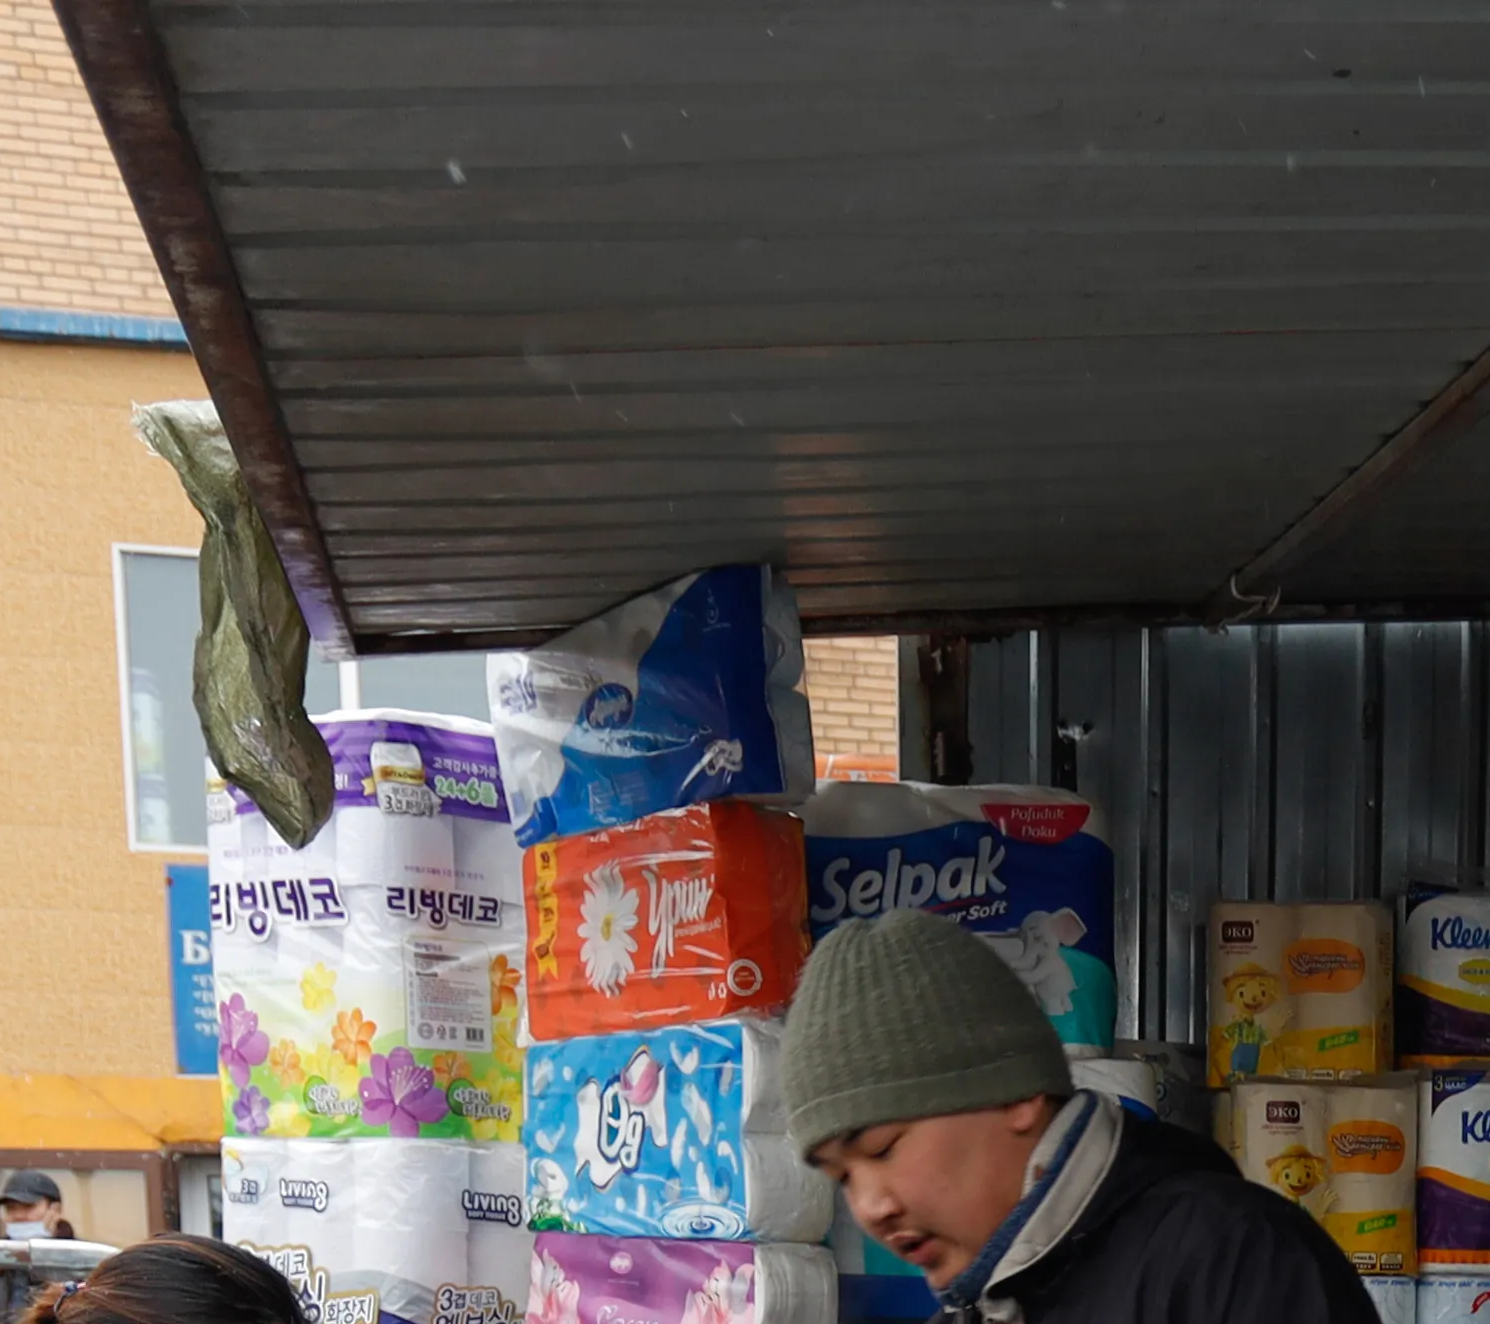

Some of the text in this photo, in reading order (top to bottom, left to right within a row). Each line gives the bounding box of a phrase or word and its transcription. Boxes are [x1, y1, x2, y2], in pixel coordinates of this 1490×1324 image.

[812, 836, 1007, 922] Selpak
[386, 886, 500, 926] 리빙데코
[969, 900, 1008, 920] Soft
